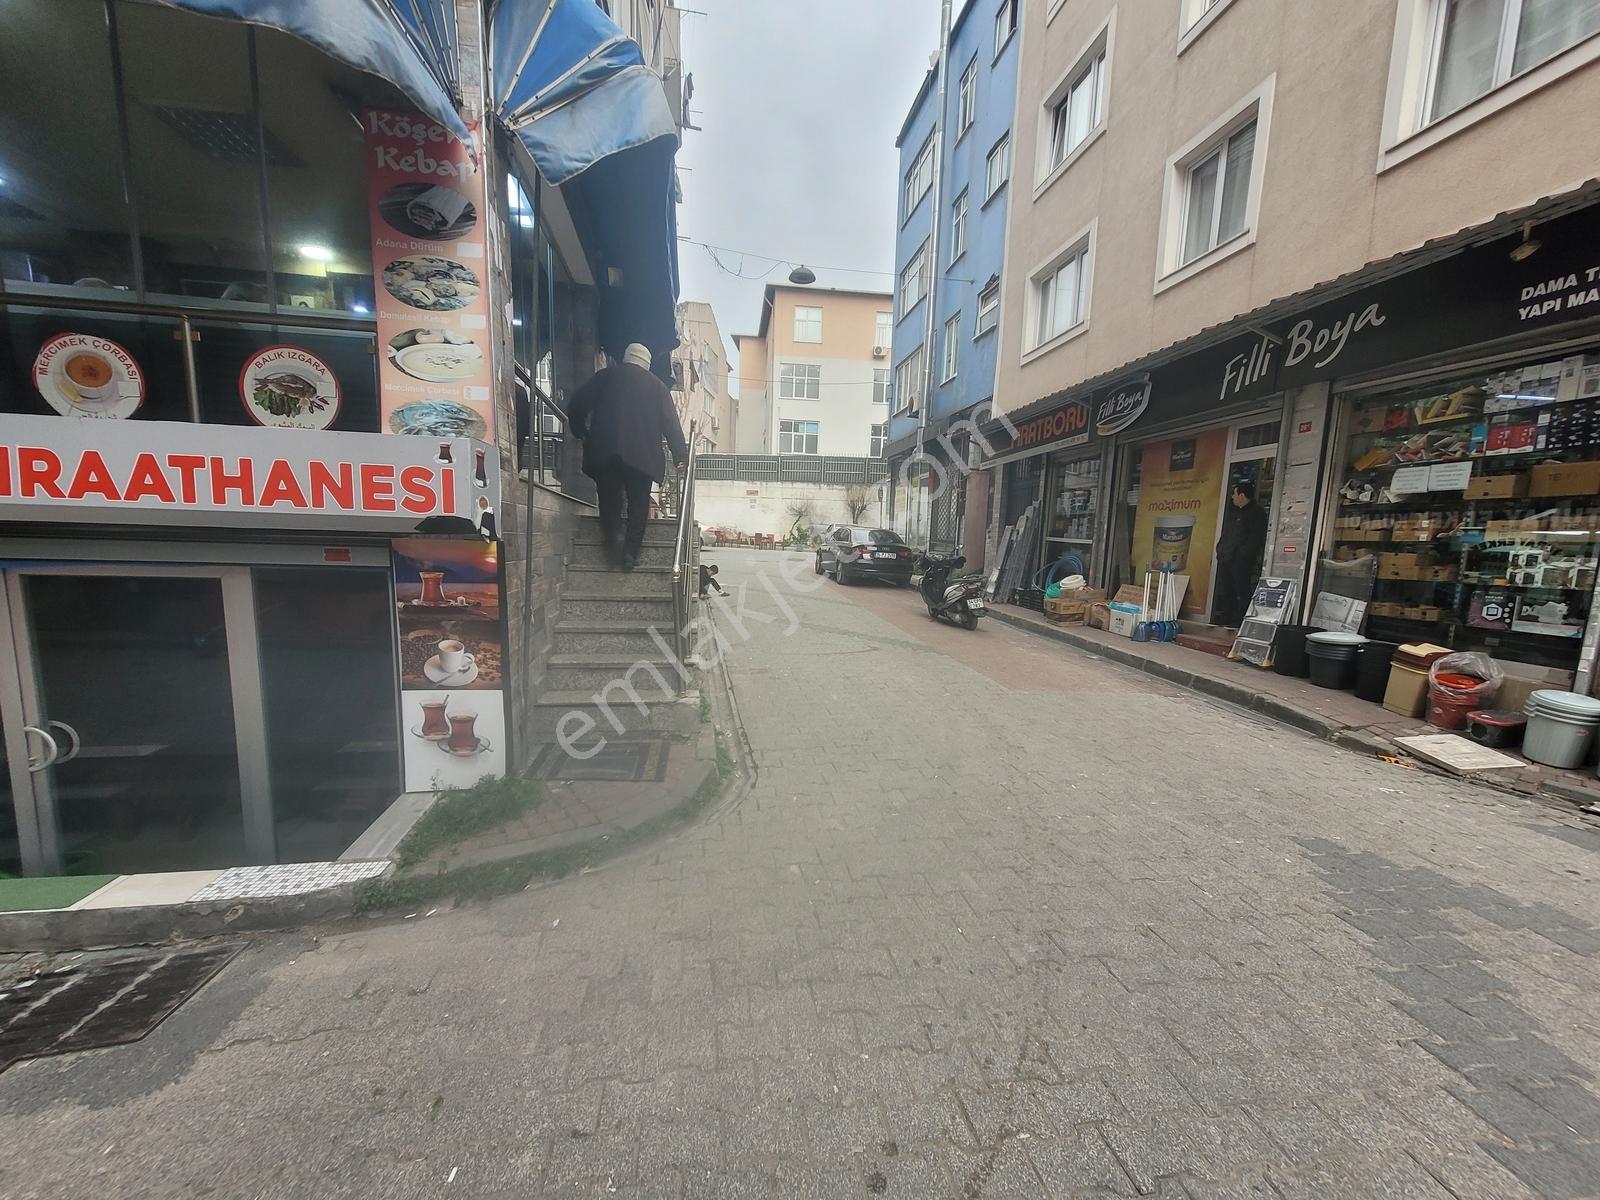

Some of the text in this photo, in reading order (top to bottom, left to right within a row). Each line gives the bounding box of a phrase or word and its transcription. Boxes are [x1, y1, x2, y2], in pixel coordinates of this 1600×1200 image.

[375, 238, 407, 249] Adana
[1521, 266, 1600, 301] DAMA T
[1518, 298, 1562, 320] YAPI
[92, 339, 138, 380] ÇORBASI
[1219, 303, 1386, 400] Filli Boya
[255, 351, 326, 376] BALIK IZGARA
[1116, 391, 1143, 413] Boya
[1148, 499, 1201, 512] maximum
